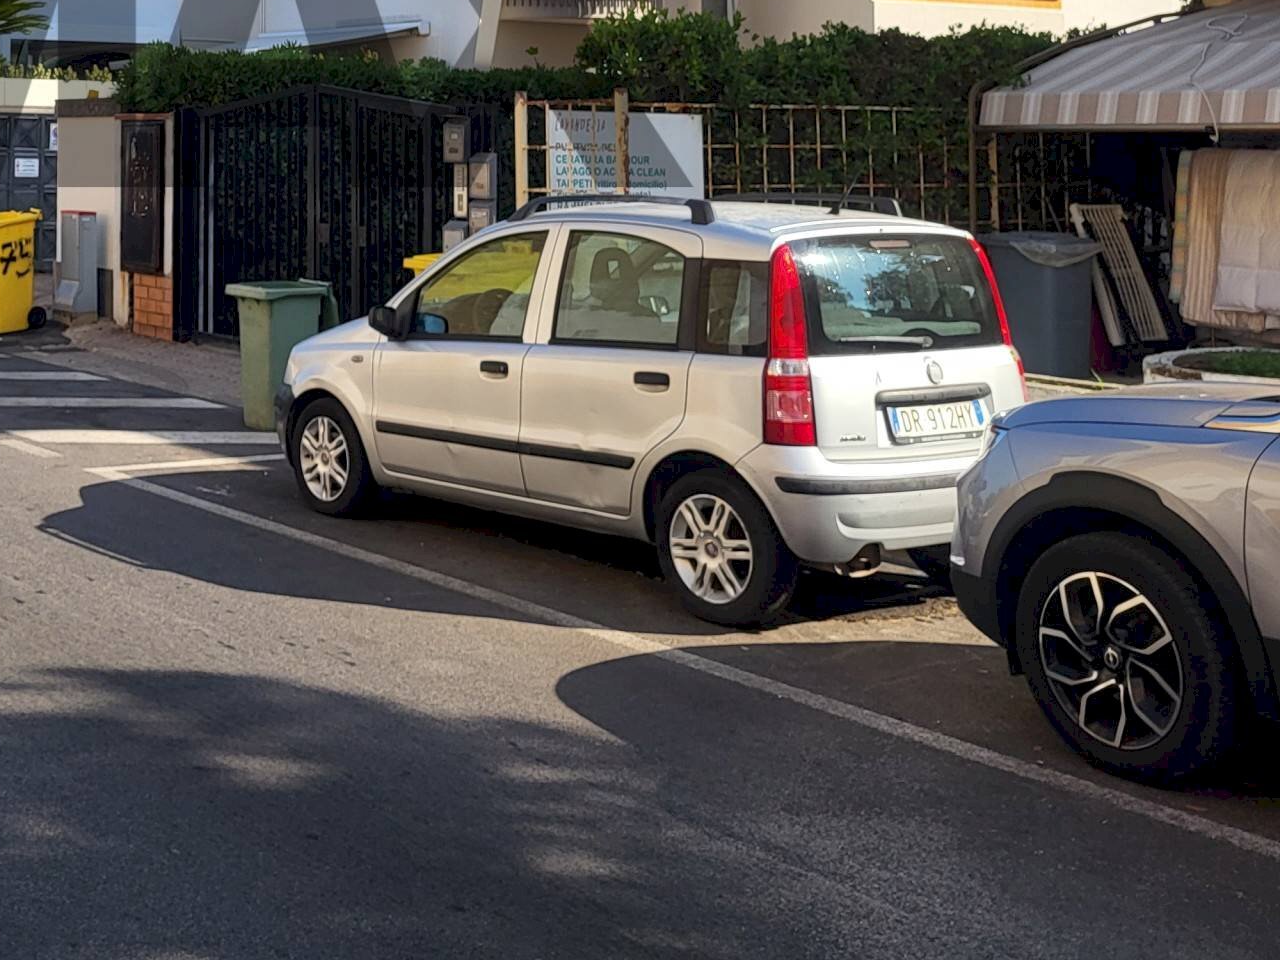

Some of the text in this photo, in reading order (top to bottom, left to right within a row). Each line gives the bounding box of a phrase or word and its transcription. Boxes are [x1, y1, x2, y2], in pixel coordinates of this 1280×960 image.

[556, 166, 666, 177] LAAGGO ACA CLEAN
[901, 403, 974, 432] DR 912HY
